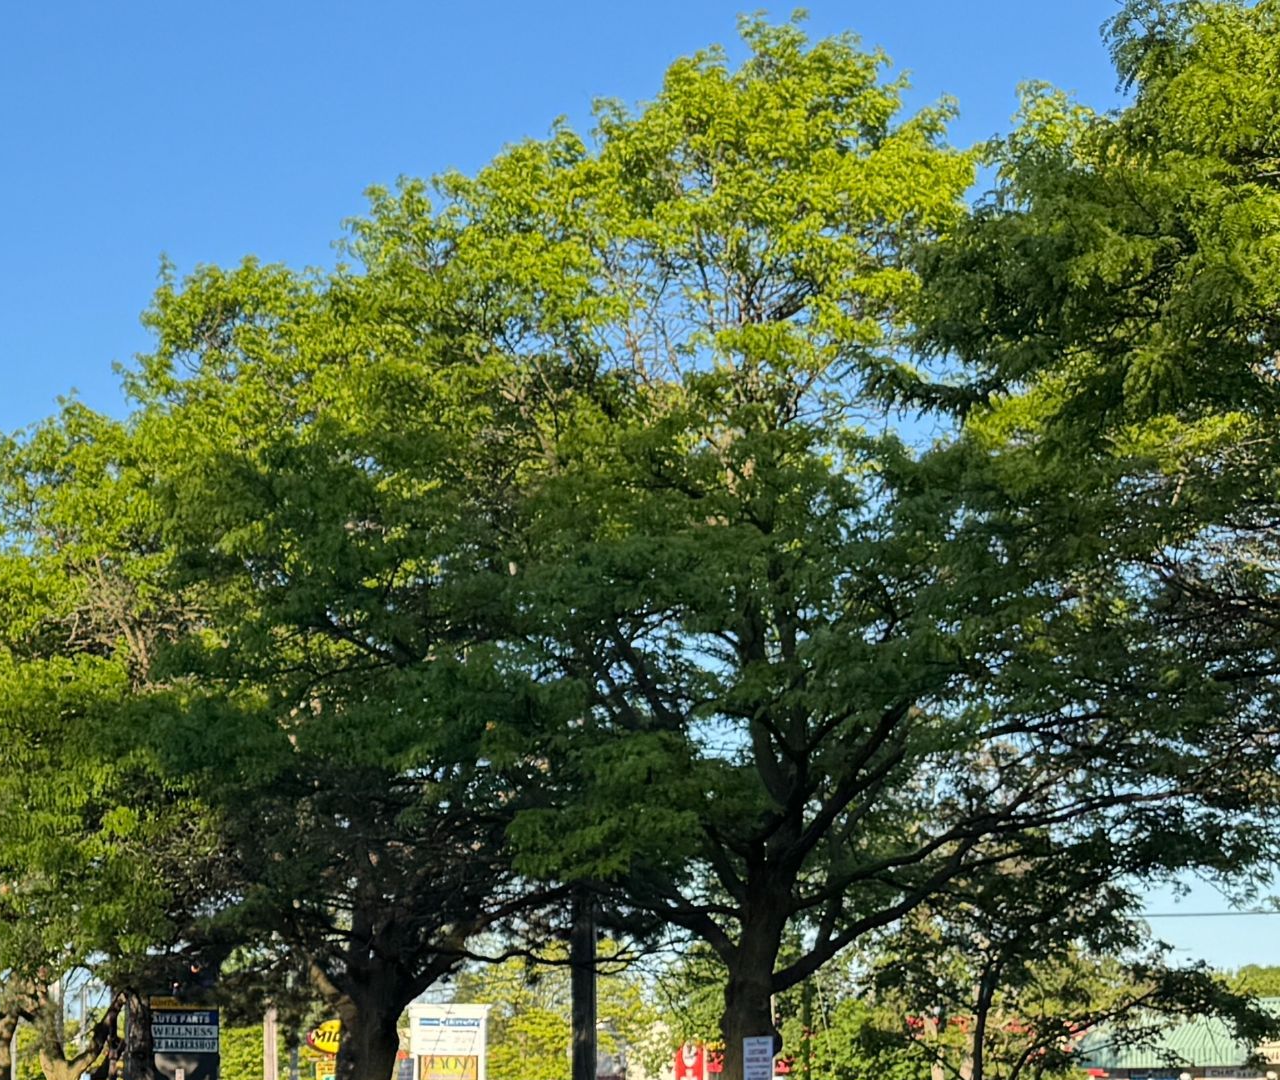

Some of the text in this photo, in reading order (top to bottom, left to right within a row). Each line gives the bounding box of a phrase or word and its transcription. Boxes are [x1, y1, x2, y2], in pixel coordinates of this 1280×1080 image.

[180, 1014, 210, 1024] PARTS
[153, 1026, 214, 1037] WELLNESS
[164, 1039, 216, 1051] BARBERSHOP
